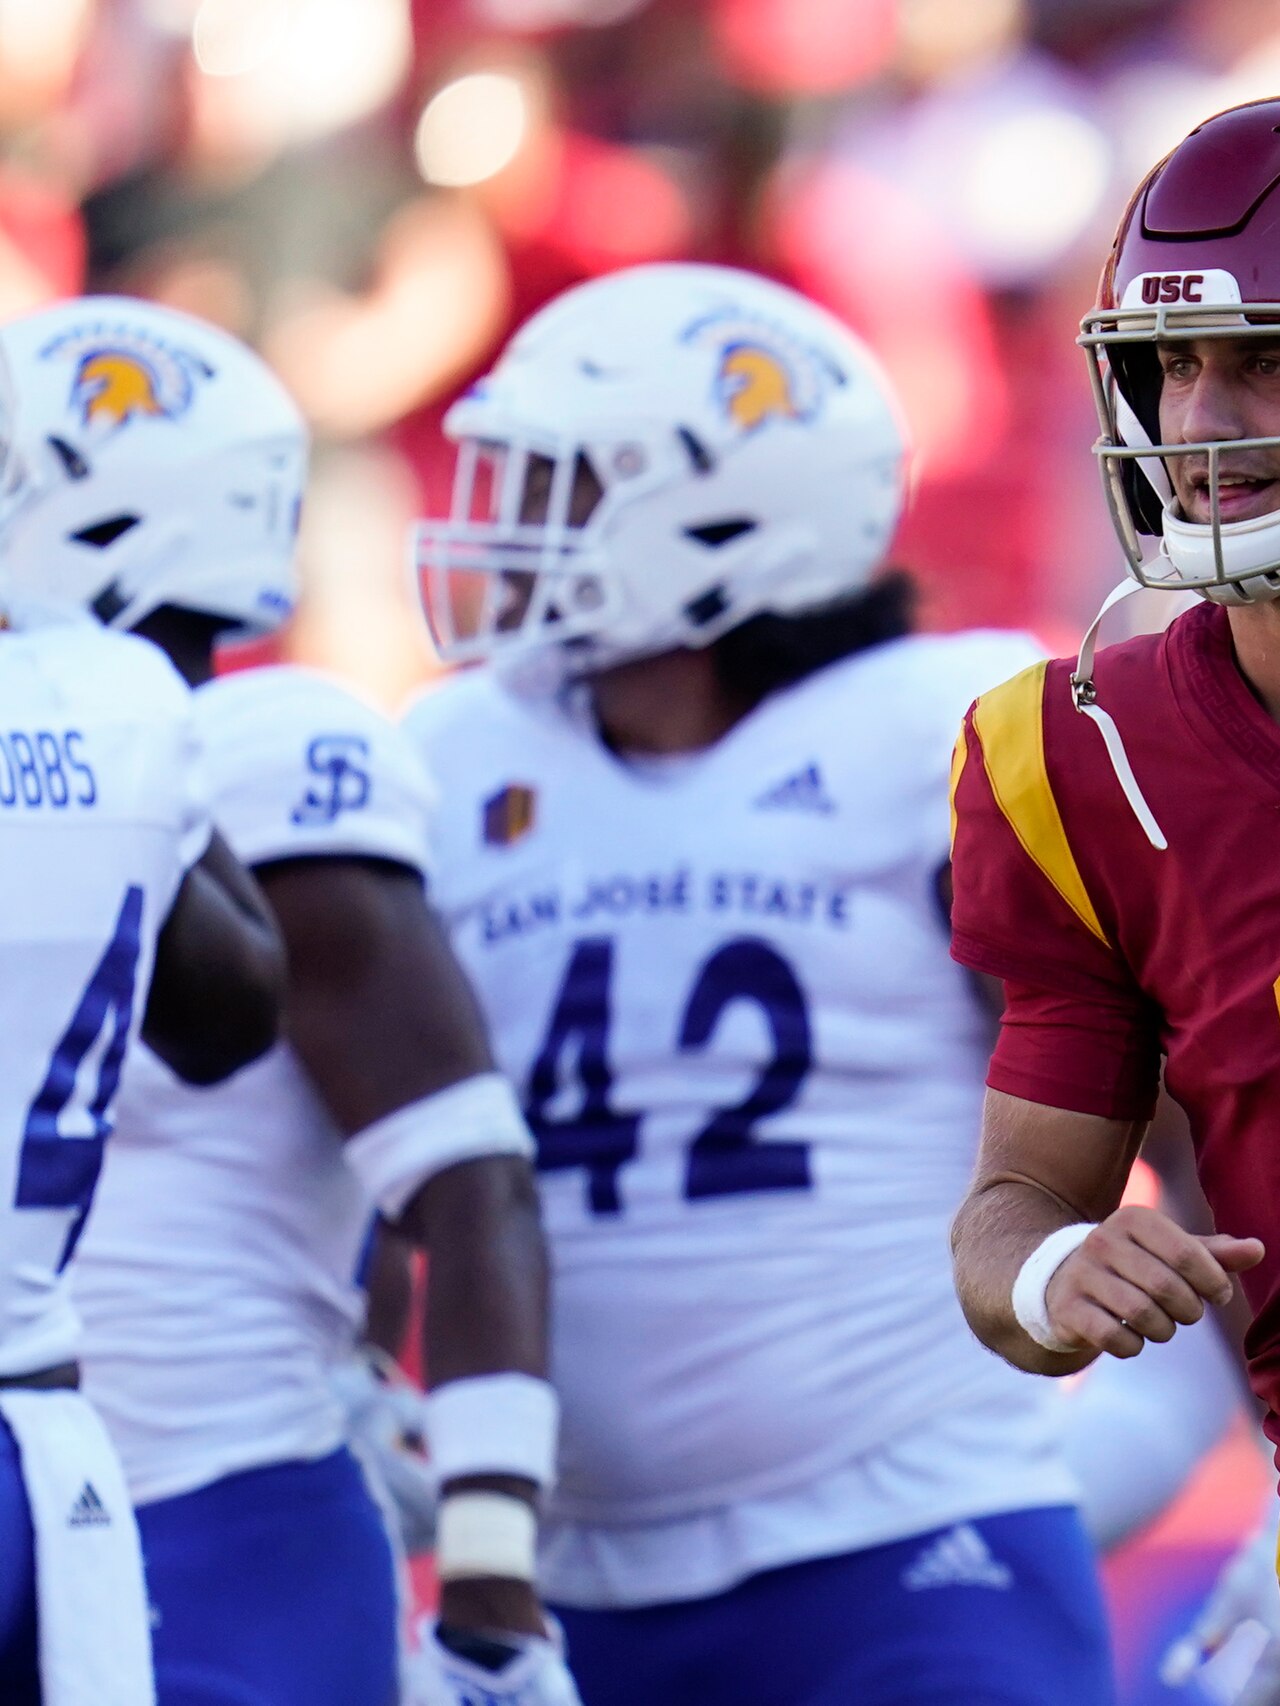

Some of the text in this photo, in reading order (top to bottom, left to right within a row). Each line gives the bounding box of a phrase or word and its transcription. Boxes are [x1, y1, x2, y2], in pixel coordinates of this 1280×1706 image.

[1142, 275, 1204, 304] USC
[484, 894, 559, 944] SAN
[711, 873, 849, 928] STATE
[526, 937, 815, 1216] 42
